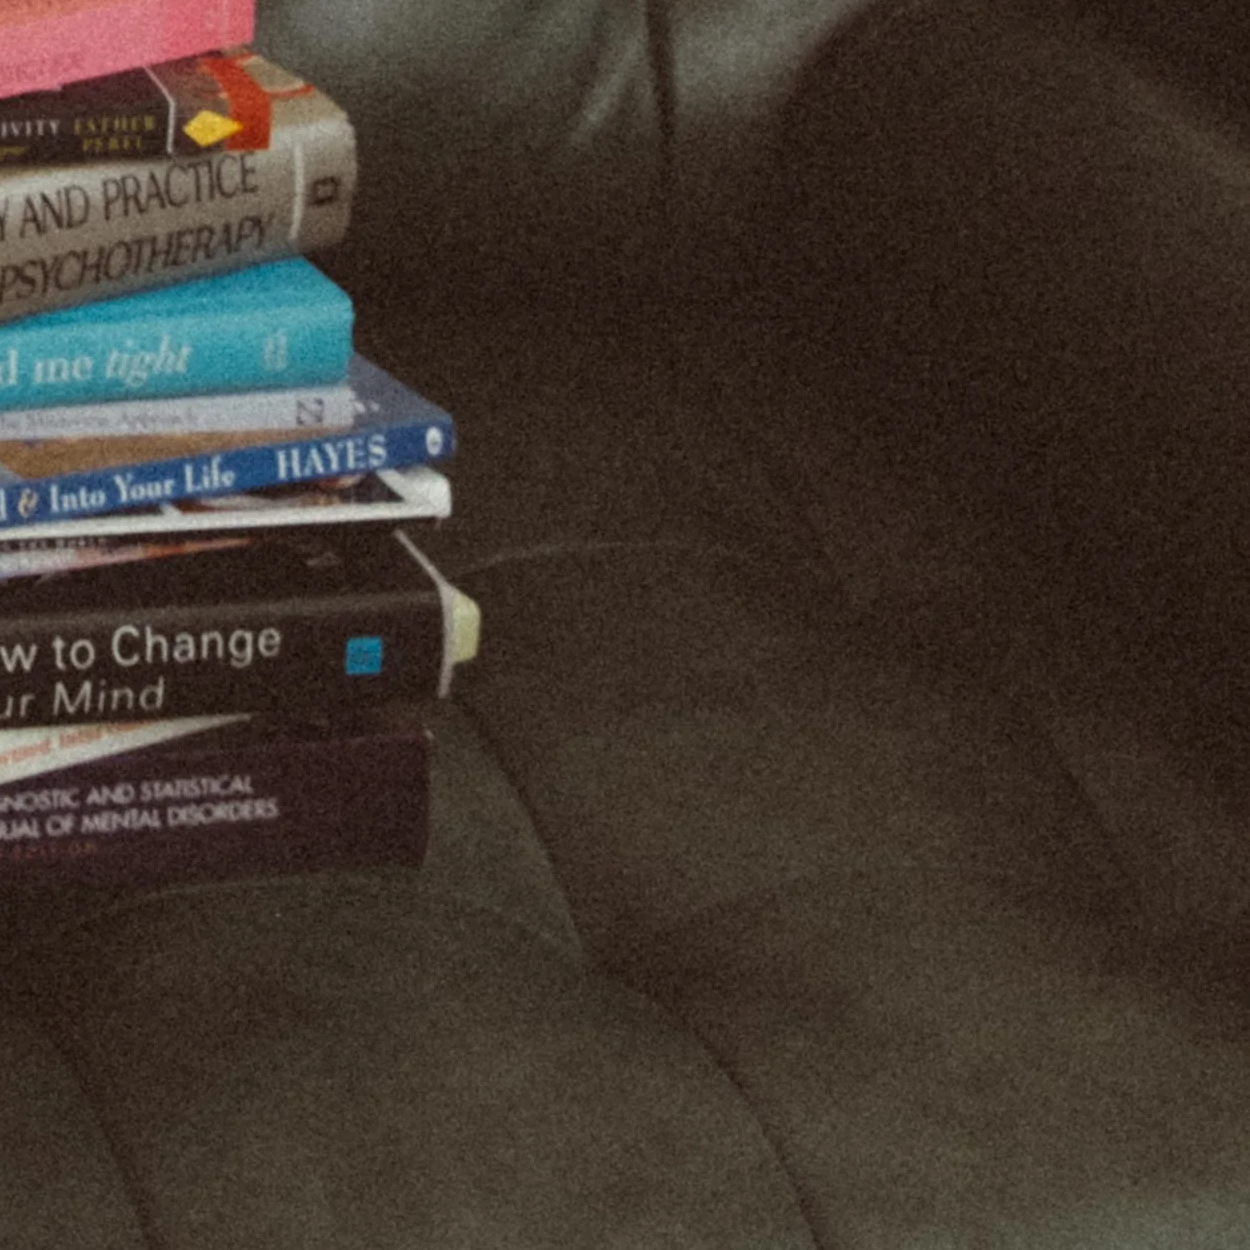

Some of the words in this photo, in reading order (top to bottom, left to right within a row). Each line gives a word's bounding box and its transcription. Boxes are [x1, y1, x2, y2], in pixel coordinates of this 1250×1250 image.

[19, 184, 90, 239] AND
[102, 154, 258, 221] PRACTICE
[34, 355, 94, 384] me
[105, 334, 191, 389] tight
[277, 433, 387, 480] HAYES
[18, 488, 38, 520] &
[50, 483, 107, 513] Into
[113, 471, 175, 504] Your
[184, 454, 235, 494] Life
[53, 636, 96, 670] to
[111, 625, 281, 668] Change
[53, 676, 165, 715] Mind
[86, 783, 133, 806] AND
[141, 775, 255, 801] STATISTICAL
[46, 814, 76, 836] OF
[81, 807, 161, 833] MENTAL
[167, 797, 279, 826] DISORDERS
